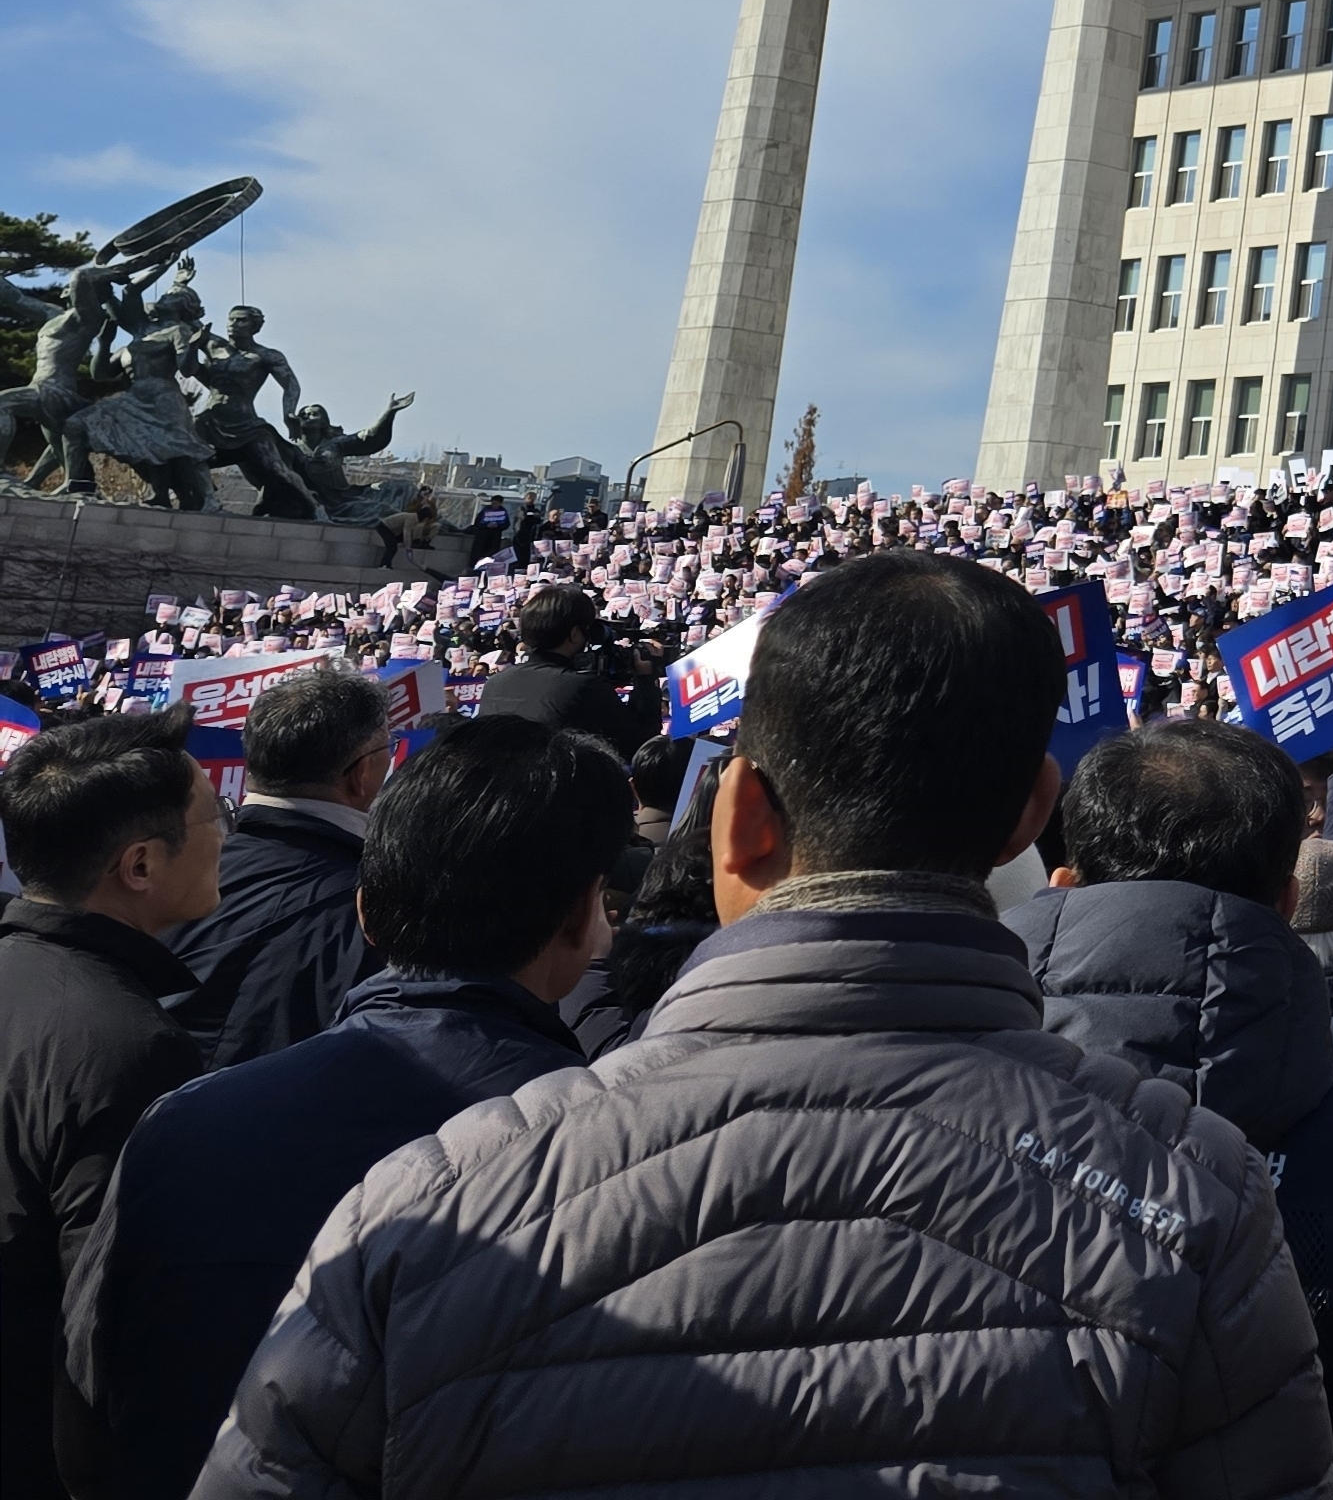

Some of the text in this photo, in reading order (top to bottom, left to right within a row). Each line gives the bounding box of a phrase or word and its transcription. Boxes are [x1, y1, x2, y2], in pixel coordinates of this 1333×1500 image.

[32, 645, 80, 672] 내란행위
[1015, 1133, 1185, 1235] PLAY YOUR BEST
